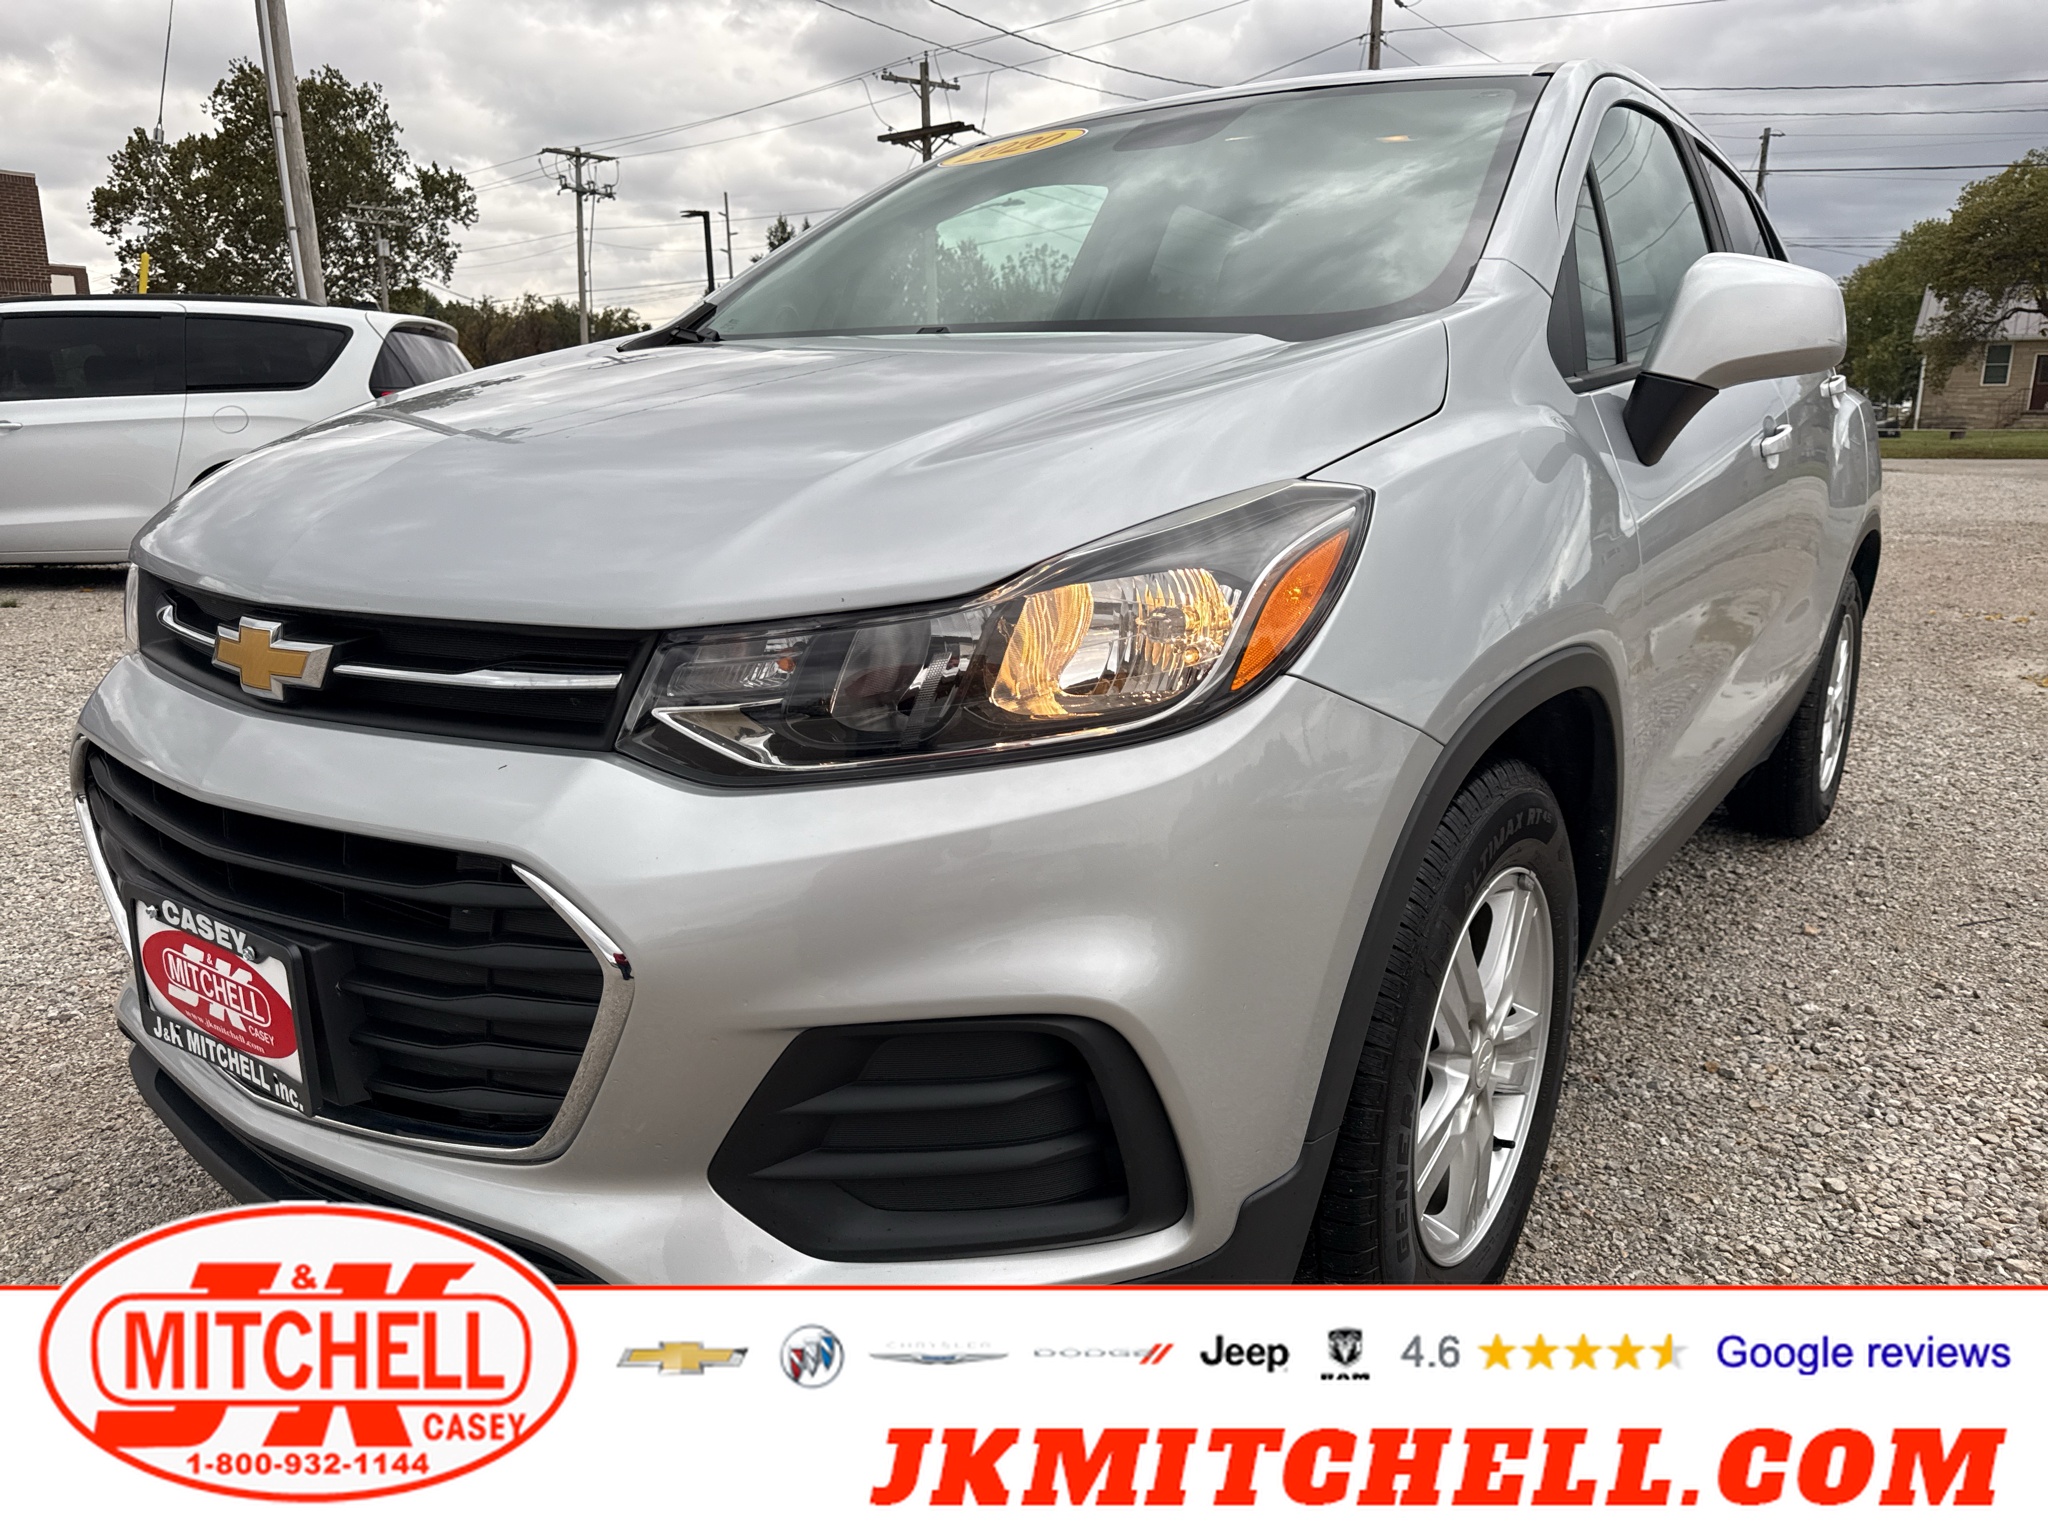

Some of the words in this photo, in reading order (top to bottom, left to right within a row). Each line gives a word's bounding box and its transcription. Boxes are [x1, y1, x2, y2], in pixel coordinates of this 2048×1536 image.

[1464, 810, 1524, 907] ALTIMAX
[161, 900, 247, 955] CASEY
[167, 952, 265, 1023] MITCHELL
[186, 1029, 271, 1093] MITCHELL
[273, 1072, 304, 1112] inc.
[248, 1025, 275, 1046] CASEY
